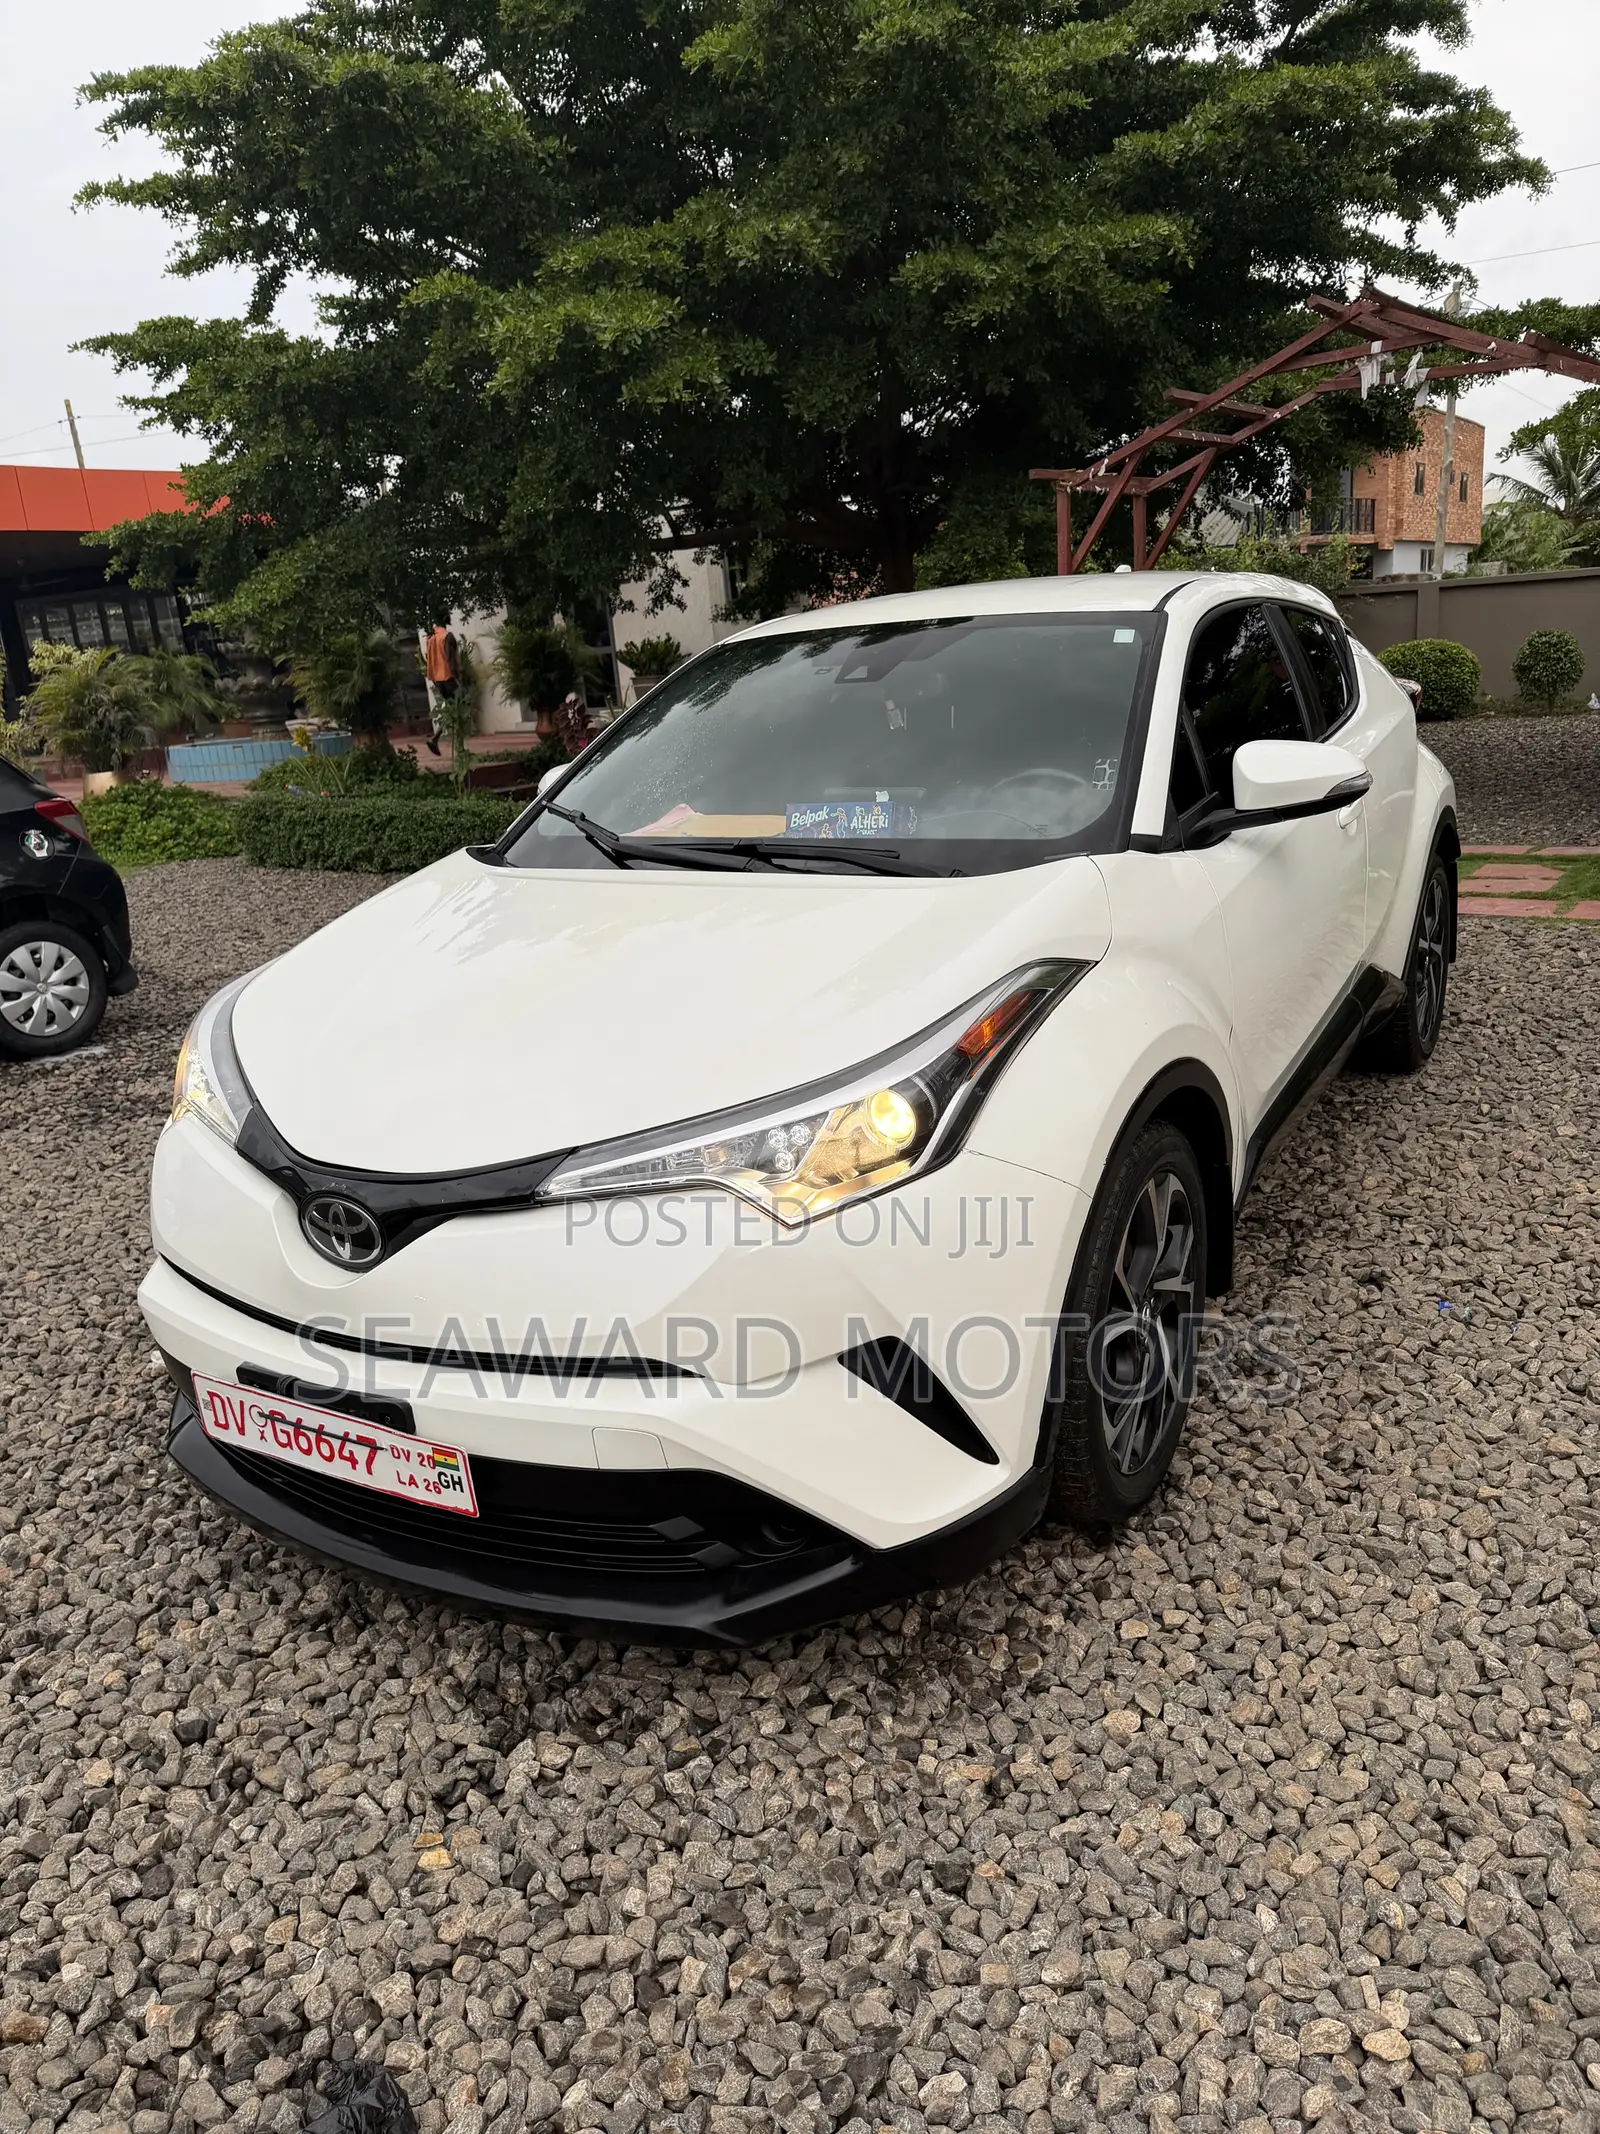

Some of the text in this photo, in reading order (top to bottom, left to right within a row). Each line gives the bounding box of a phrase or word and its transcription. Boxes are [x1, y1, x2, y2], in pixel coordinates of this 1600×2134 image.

[790, 805, 830, 828] Belpak
[206, 1390, 378, 1476] DV G6647
[389, 1443, 411, 1463] DV
[395, 1469, 443, 1495] LA 26
[437, 1471, 465, 1494] GH
